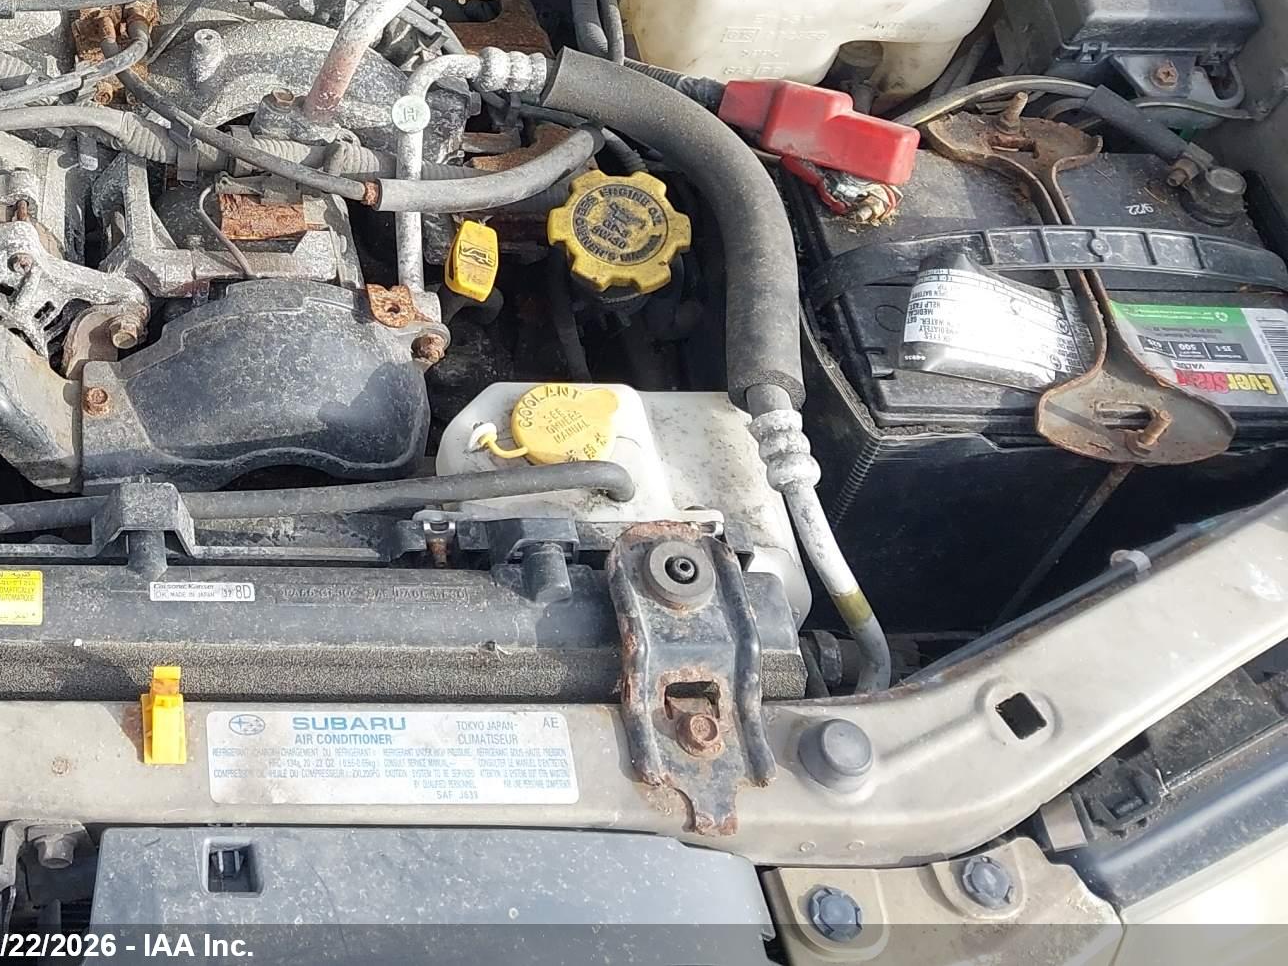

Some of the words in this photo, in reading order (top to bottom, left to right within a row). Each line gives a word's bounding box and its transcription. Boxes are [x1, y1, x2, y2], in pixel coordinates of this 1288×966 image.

[1178, 342, 1197, 352] 500
[518, 385, 582, 428] COOLANT
[235, 585, 252, 599] 8D
[292, 716, 407, 731] SUBARU
[456, 720, 485, 731] TOKYO
[542, 717, 560, 729] AE
[294, 734, 314, 745] AIR
[317, 734, 393, 745] CONDITIONER
[457, 734, 519, 745] CLIMATISEUR
[436, 790, 453, 800] SAF
